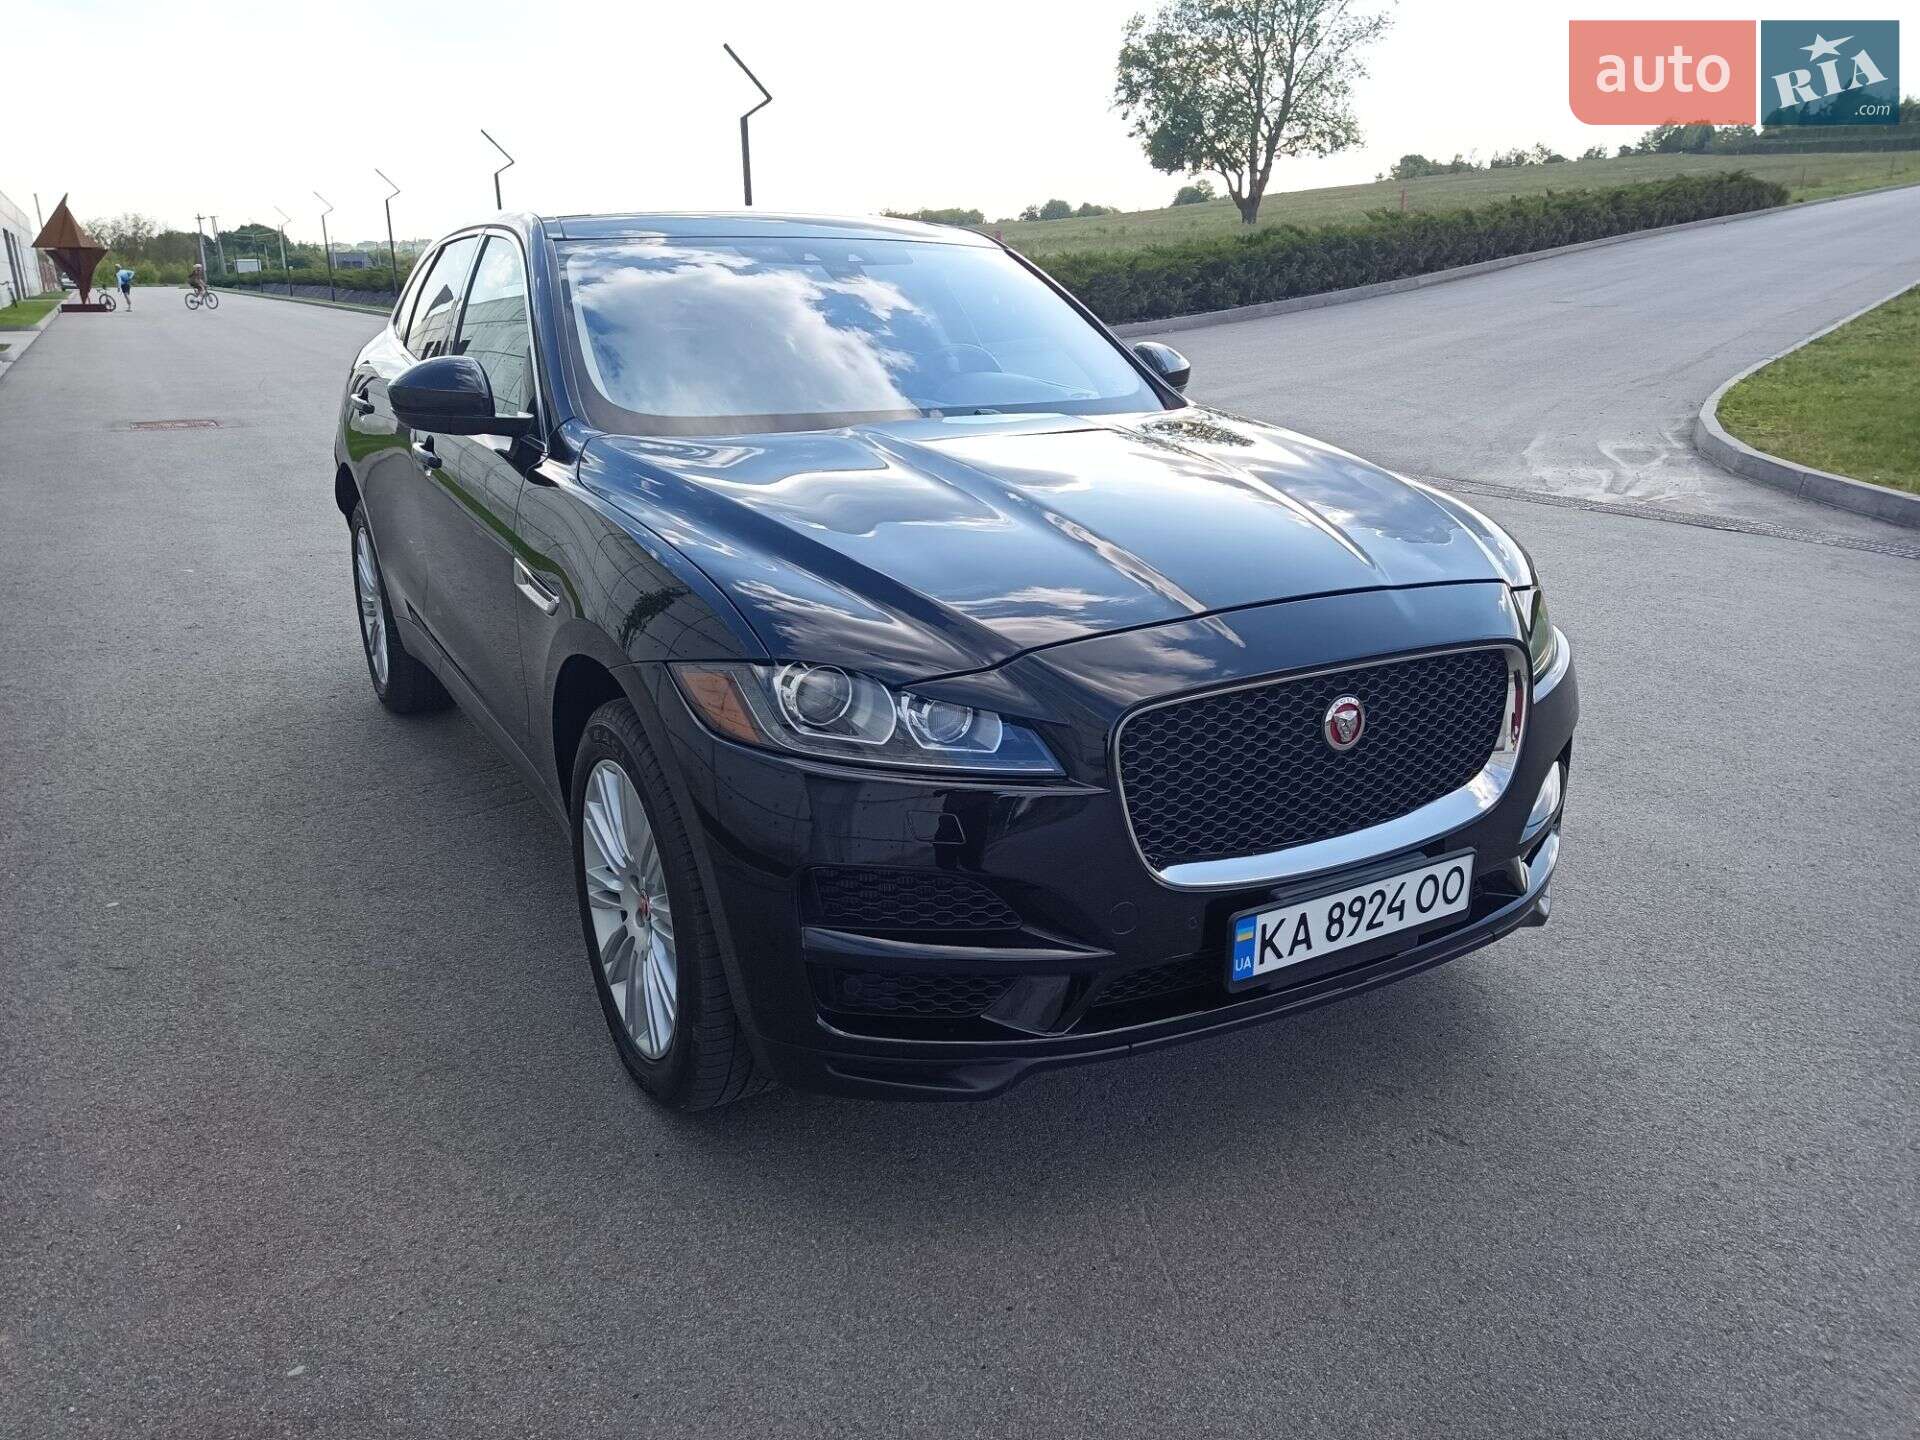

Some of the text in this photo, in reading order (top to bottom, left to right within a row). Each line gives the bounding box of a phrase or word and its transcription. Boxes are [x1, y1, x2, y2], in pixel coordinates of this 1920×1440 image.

[1258, 866, 1465, 966] KA 8924 OO
[1235, 956, 1252, 972] UA
